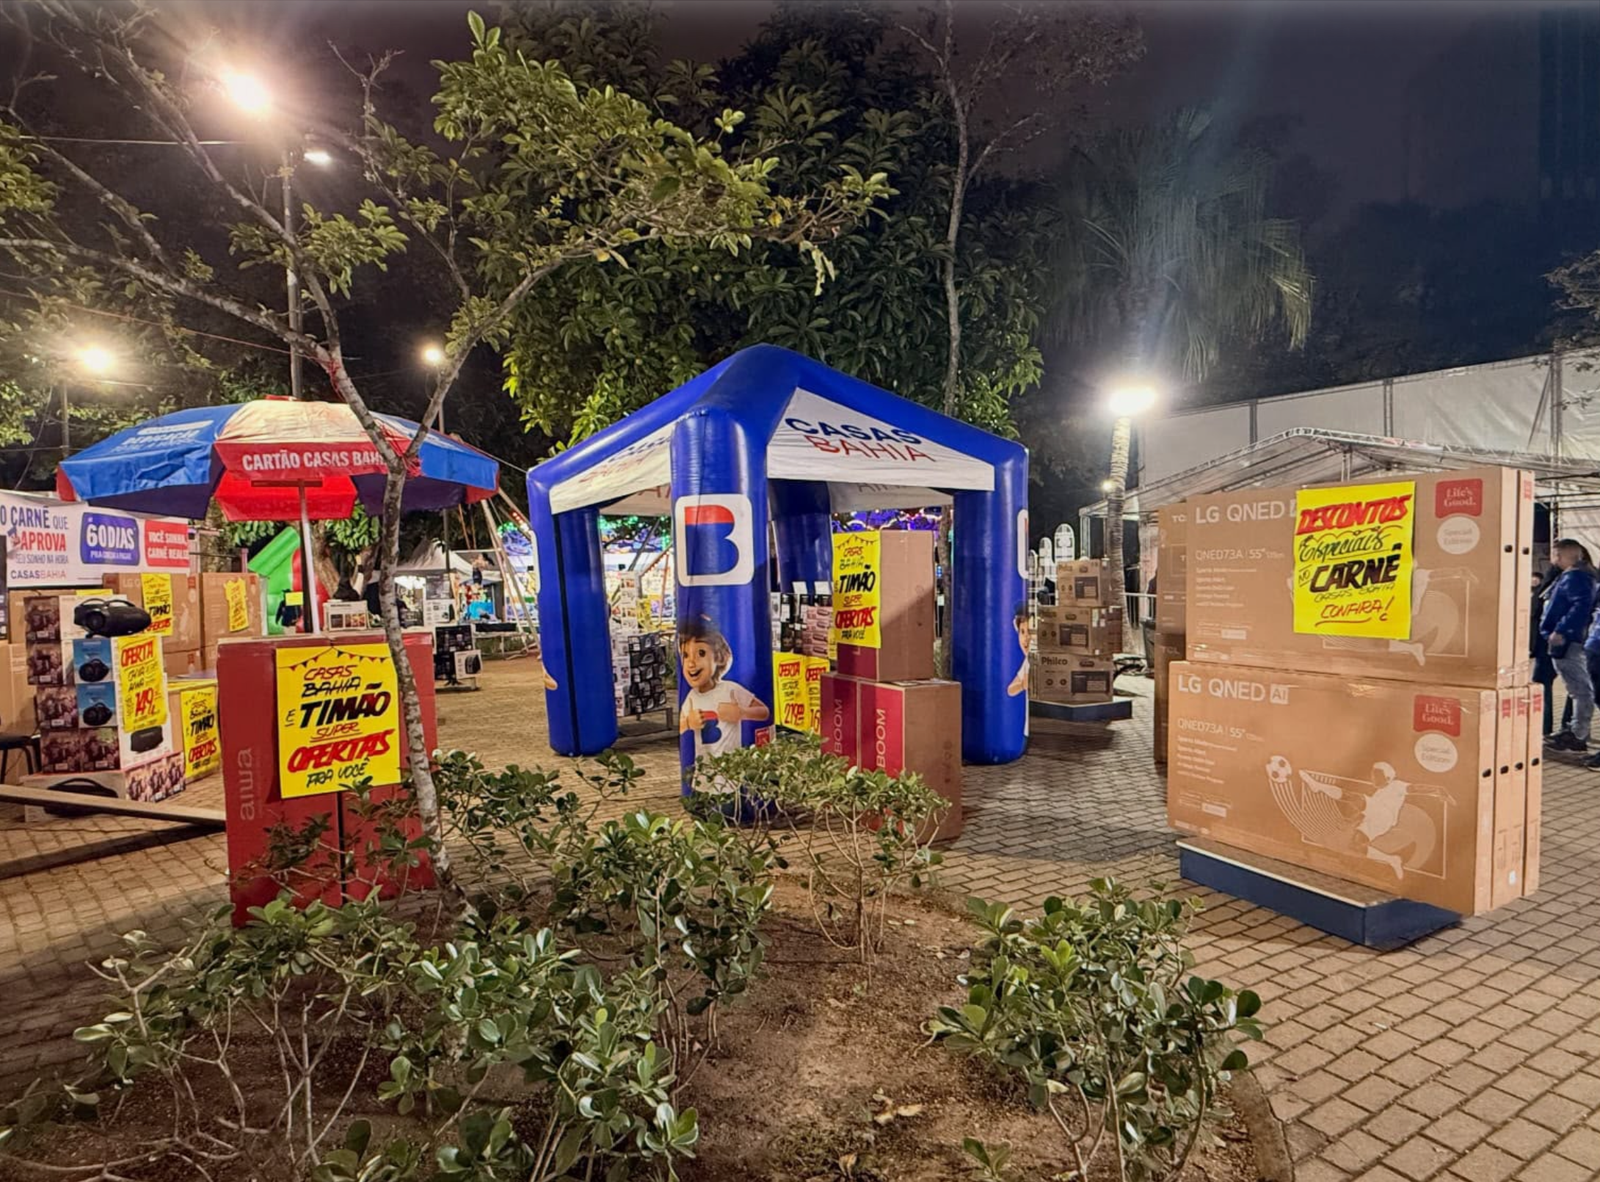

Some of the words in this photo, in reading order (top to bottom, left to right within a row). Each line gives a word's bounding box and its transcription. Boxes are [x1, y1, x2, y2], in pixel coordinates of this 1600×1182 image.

[784, 417, 923, 444] CASAS
[242, 448, 301, 470] CARTÃO
[303, 451, 349, 467] CASAS
[803, 434, 937, 462] BAHIA
[1446, 486, 1474, 498] Life's
[11, 506, 50, 528] CARNÊ
[53, 515, 69, 530] QUE
[1172, 514, 1187, 522] TC
[1195, 506, 1220, 524] LG
[1226, 500, 1285, 522] QNED
[1296, 494, 1413, 536] DESCONTOS
[20, 530, 67, 552] APROVA
[26, 554, 46, 564] SONHO
[1309, 542, 1403, 593] CARNÊ
[839, 564, 876, 593] TIMÃO
[835, 606, 877, 629] OFERTAS
[120, 640, 154, 668] OFERTA
[1041, 657, 1068, 666] Philco
[304, 665, 357, 681] CASAS
[301, 676, 361, 698] BAHIA
[1178, 674, 1202, 694] LG
[1208, 678, 1266, 702] QNED
[286, 709, 296, 723] E
[300, 682, 391, 729] TIMÃO
[314, 722, 360, 740] SUPER
[876, 708, 886, 768] BOOM
[287, 728, 396, 773] OFERTAS
[237, 747, 255, 821] aiwa
[306, 769, 334, 788] PRA
[338, 757, 371, 780] VOCÊ
